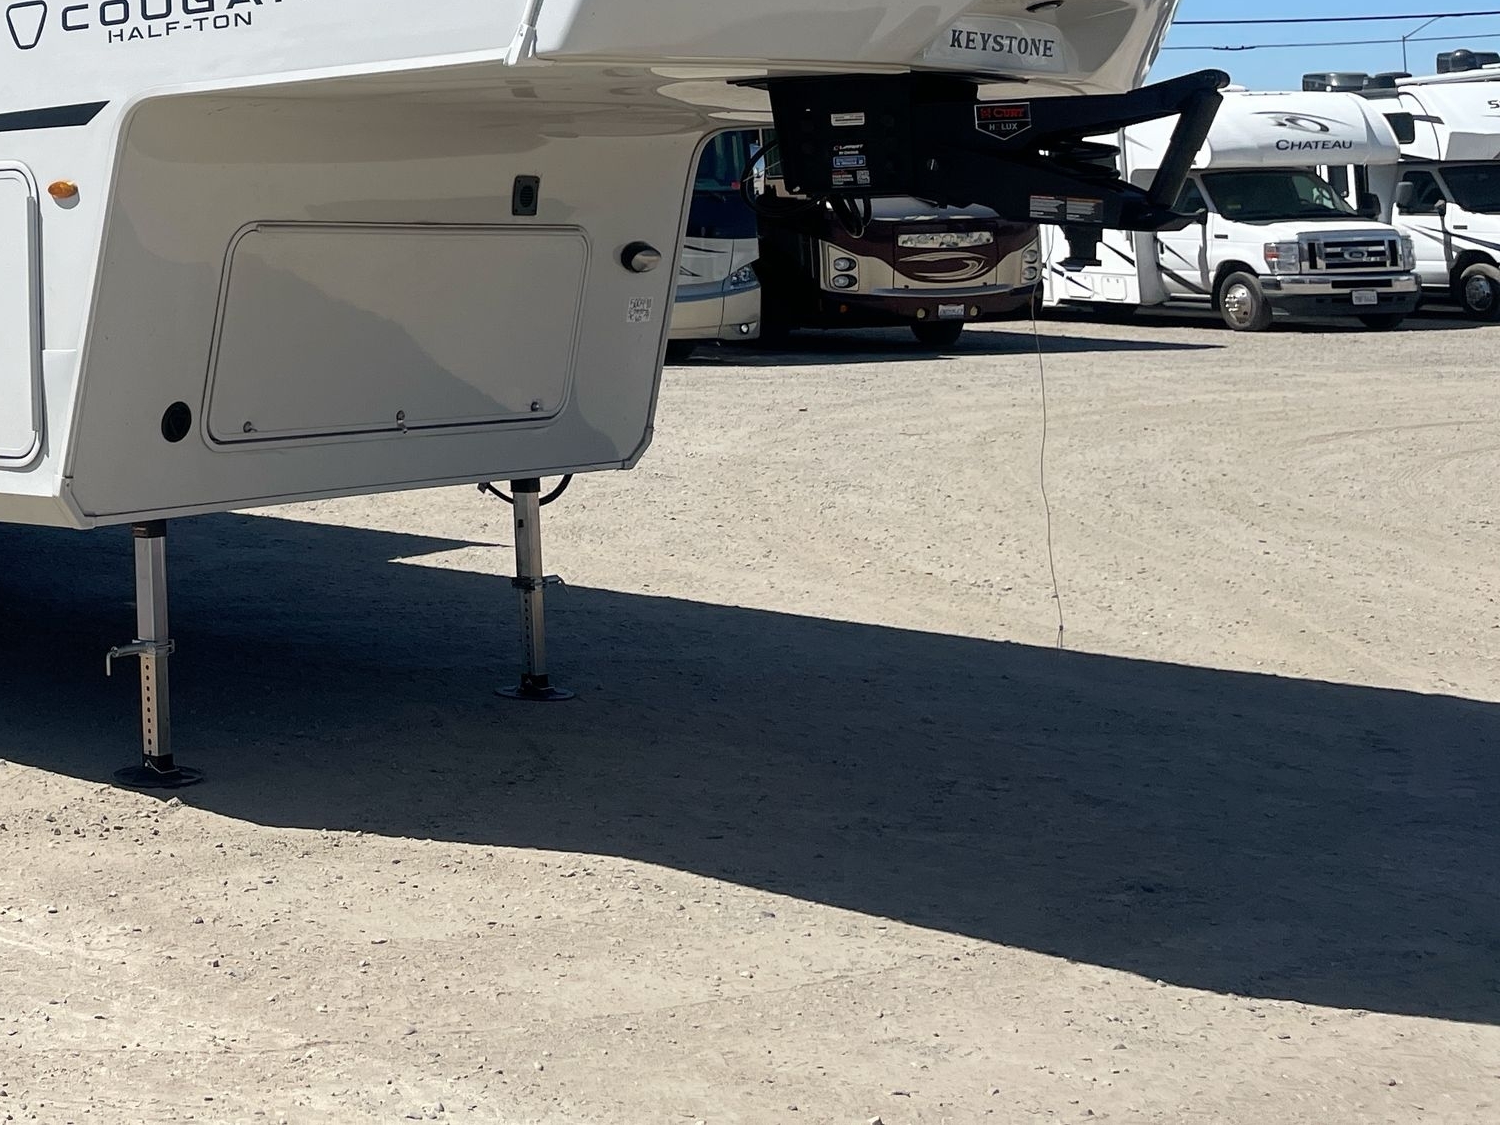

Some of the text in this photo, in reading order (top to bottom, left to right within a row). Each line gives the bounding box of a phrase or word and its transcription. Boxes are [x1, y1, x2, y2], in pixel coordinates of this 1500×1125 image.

[107, 11, 253, 44] HALF-TON
[949, 28, 1055, 58] KEYSTONE
[988, 122, 1018, 131] HLUX
[1275, 139, 1353, 151] CHATEAU
